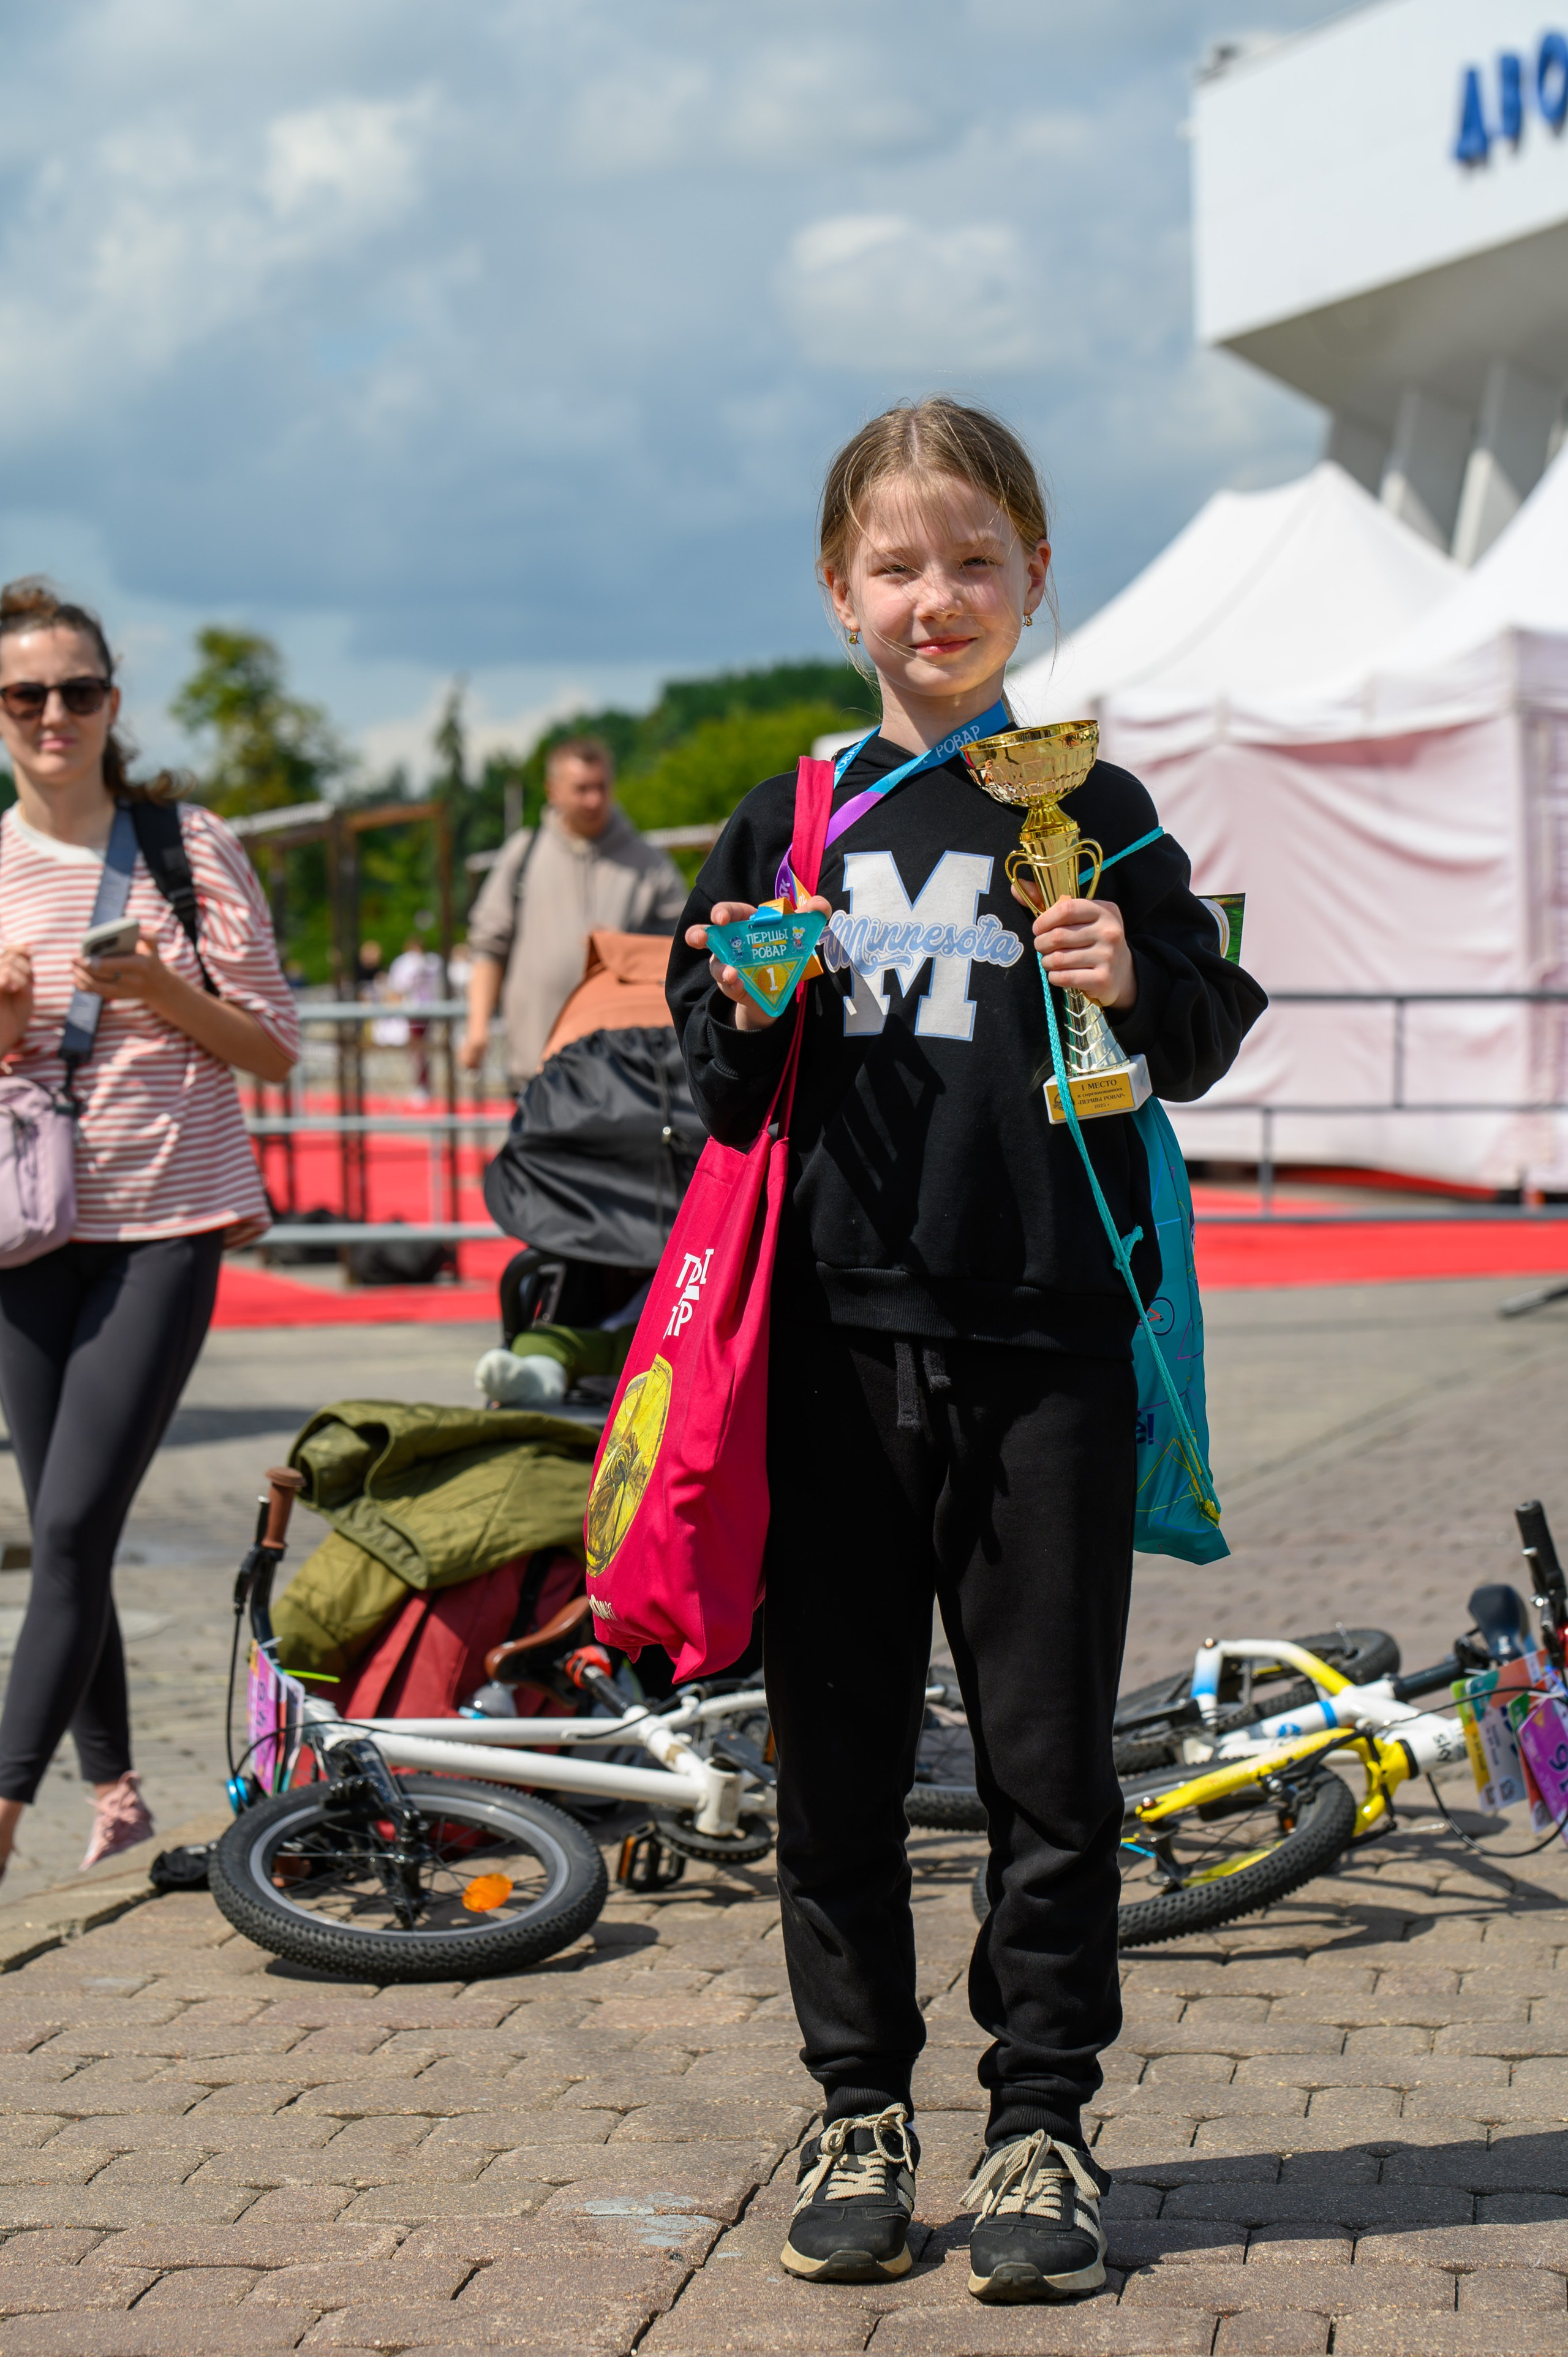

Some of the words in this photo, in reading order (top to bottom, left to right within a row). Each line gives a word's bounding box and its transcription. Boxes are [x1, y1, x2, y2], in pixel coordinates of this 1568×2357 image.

[745, 929, 789, 945] ПЕРШЫ
[820, 910, 1024, 978] Minnesota
[751, 945, 787, 960] РОВАР
[766, 967, 778, 991] 1
[1088, 1079, 1117, 1090] МЕСТО
